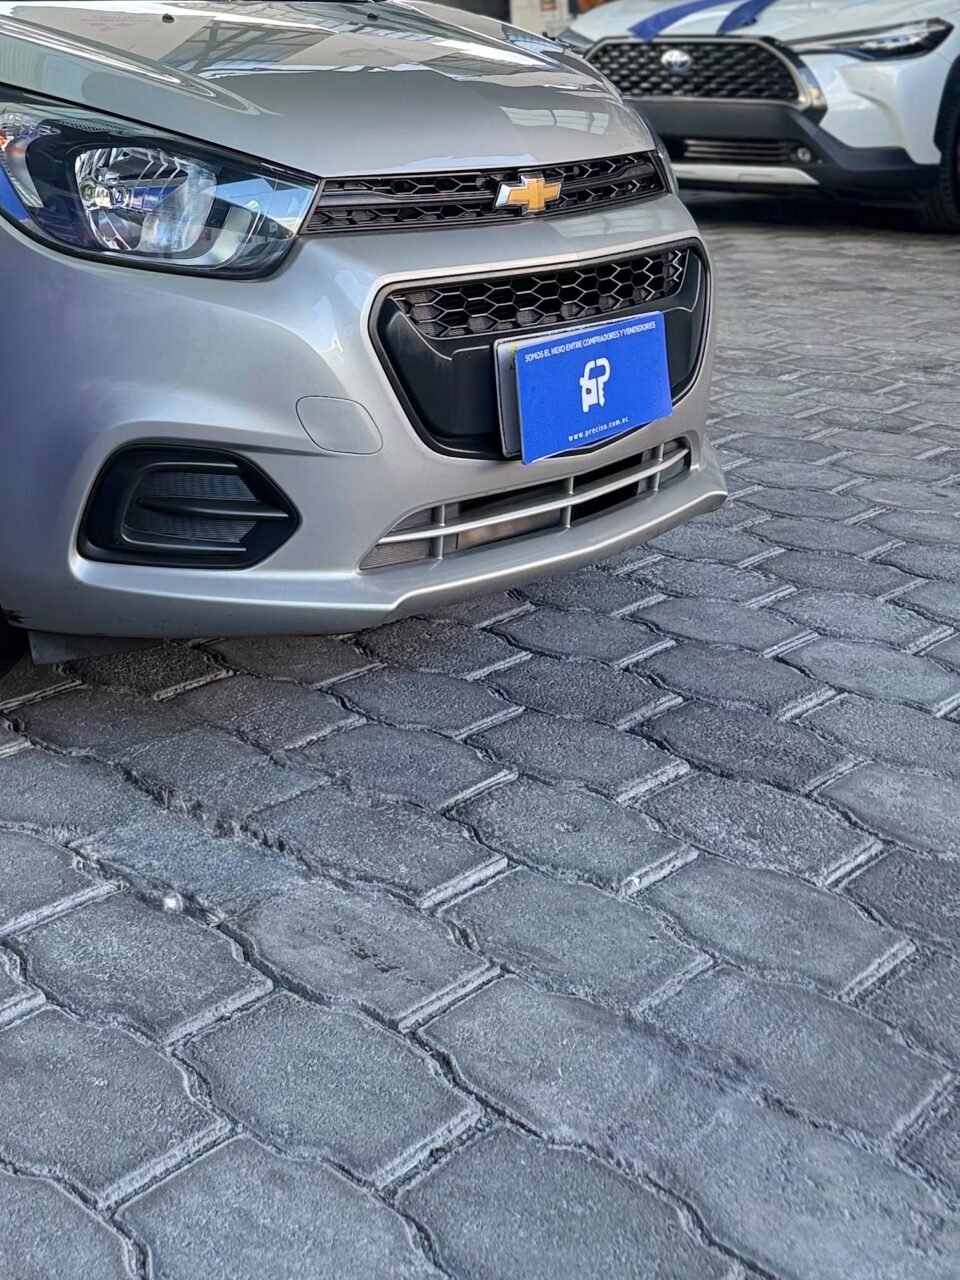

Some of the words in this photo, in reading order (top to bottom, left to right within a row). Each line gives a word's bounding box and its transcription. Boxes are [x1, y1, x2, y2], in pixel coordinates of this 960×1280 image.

[524, 350, 544, 362] SOMOS
[544, 348, 551, 357] EL
[551, 344, 565, 355] NEXO
[566, 340, 583, 351] ENTRE
[583, 331, 620, 347] COMPRADORES
[624, 321, 656, 336] VENDEDORES
[568, 416, 629, 441] www.preciso.com.ec
